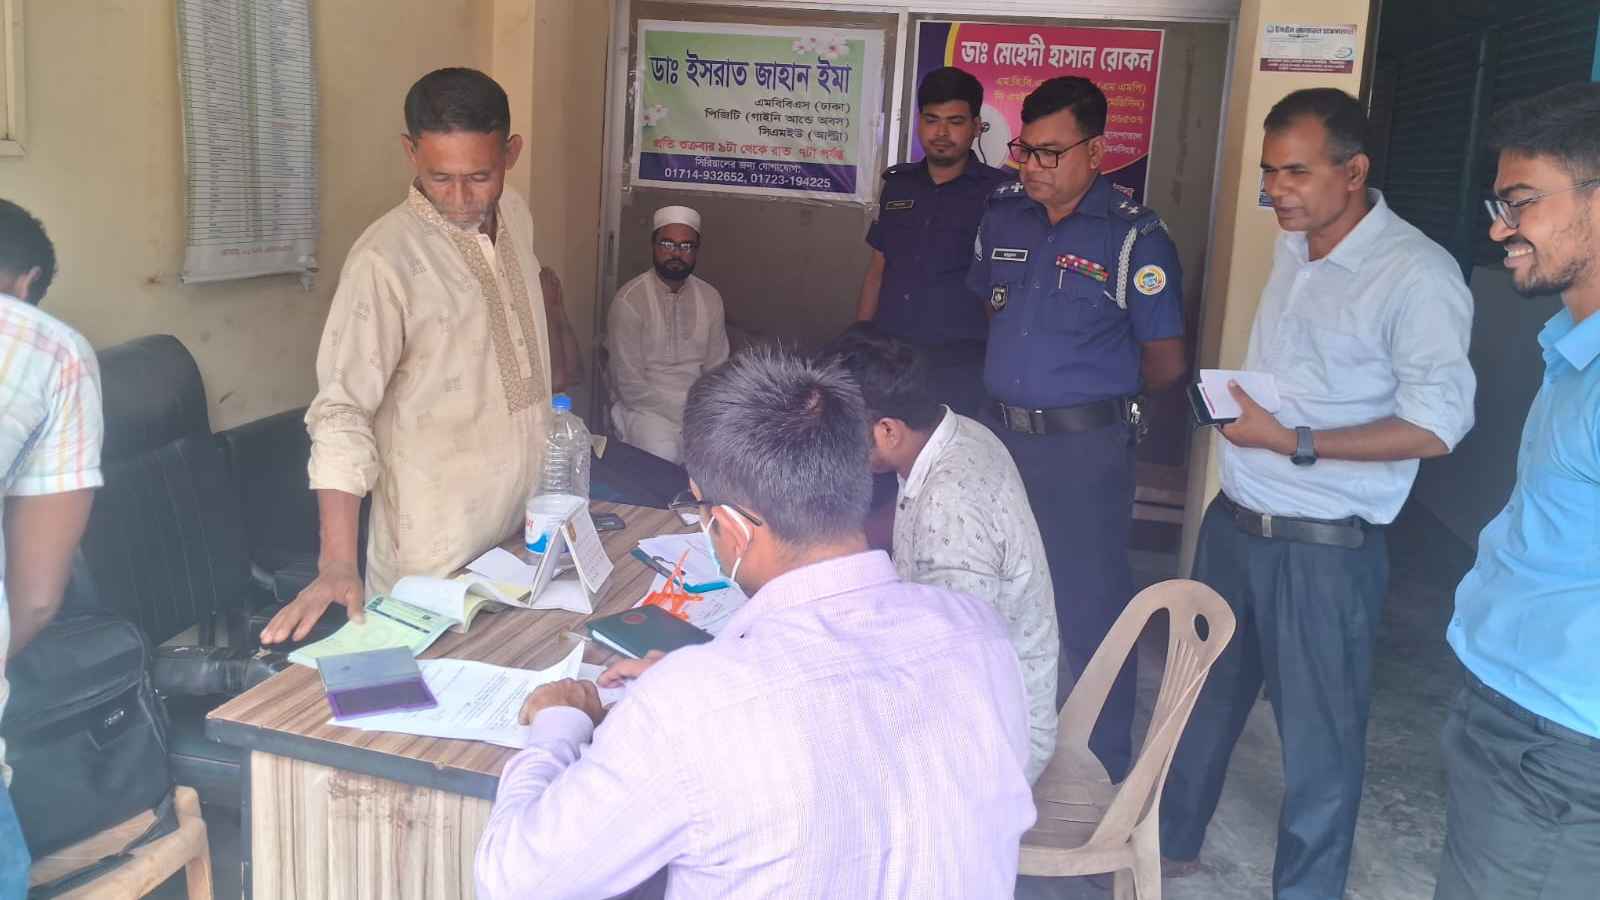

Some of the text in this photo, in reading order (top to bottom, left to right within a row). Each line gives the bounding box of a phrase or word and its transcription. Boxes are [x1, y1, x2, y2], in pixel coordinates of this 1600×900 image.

[961, 33, 1154, 72] ডাঃ মেহেদী হাসান রোকন
[649, 49, 852, 95] ডাঃ ইসরাত জাহান ইমা
[704, 106, 741, 121] পিজিটি
[754, 96, 810, 111] এমবিবিএস
[664, 167, 831, 189] 01714-932652, 01723-194225
